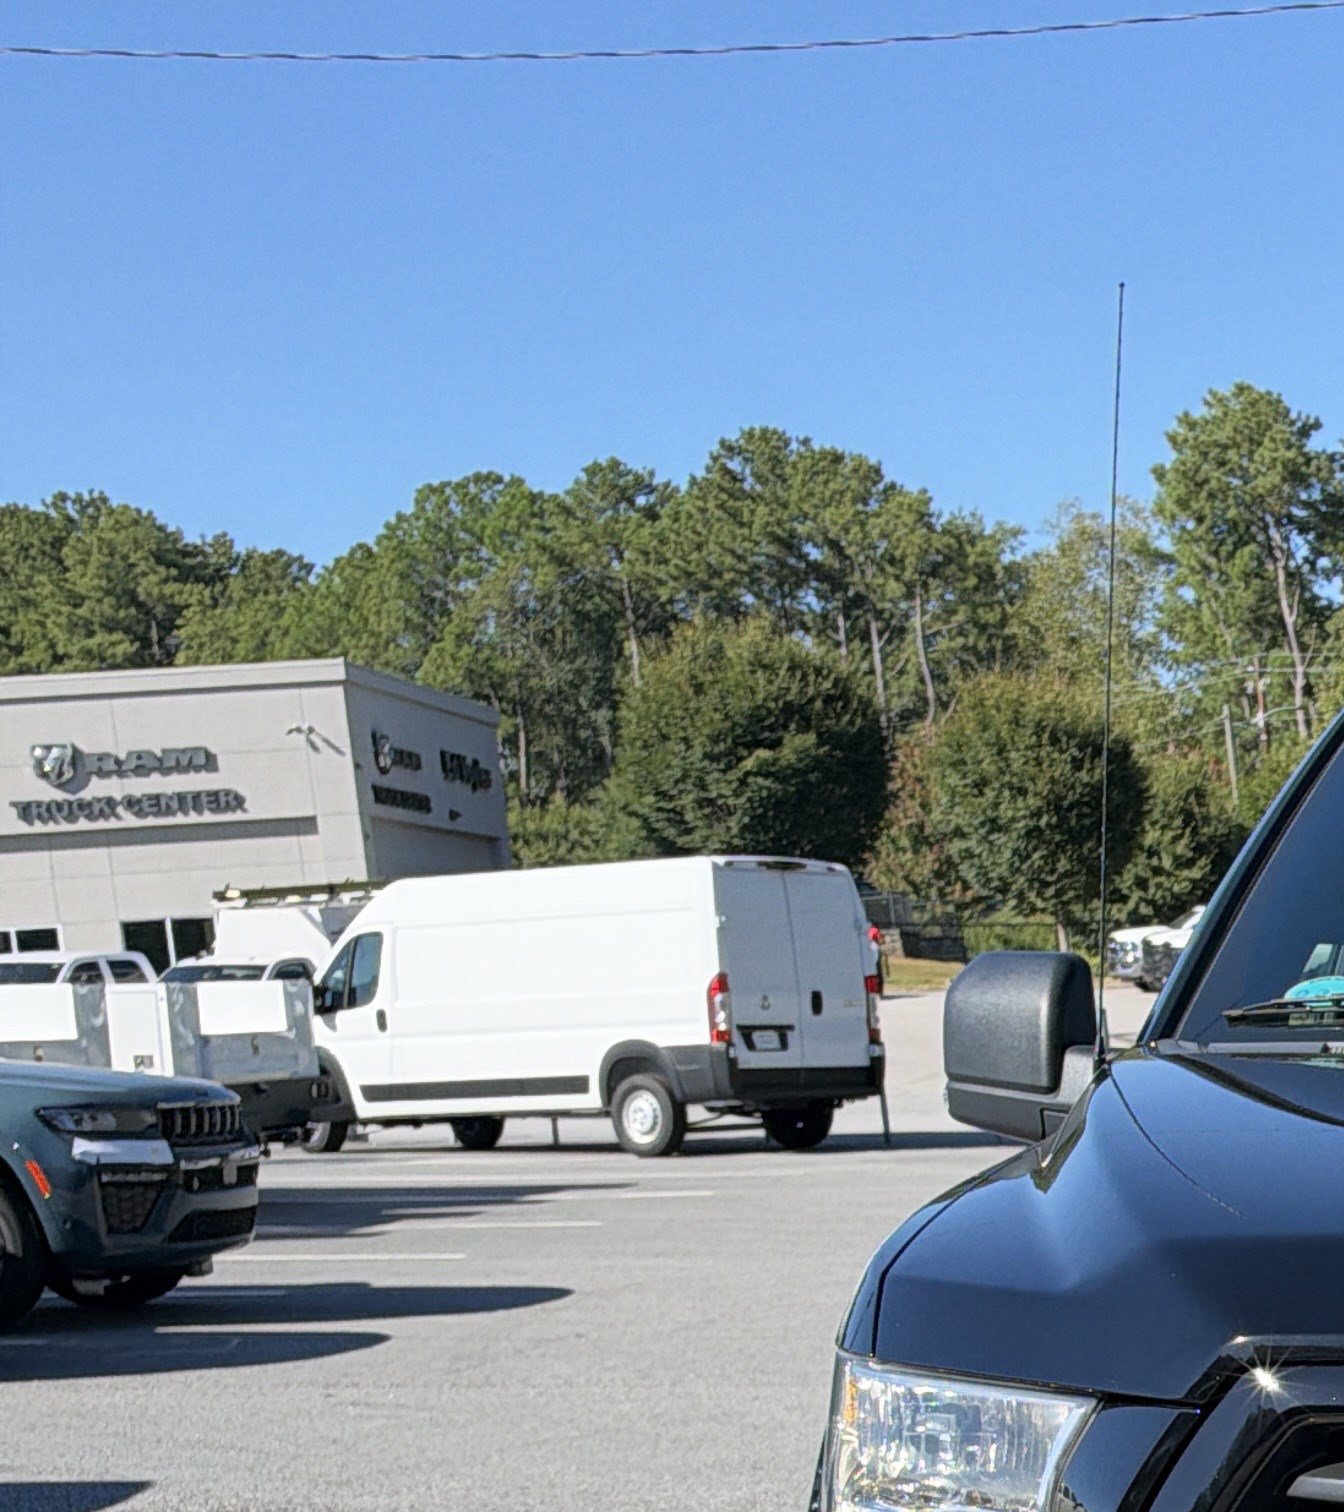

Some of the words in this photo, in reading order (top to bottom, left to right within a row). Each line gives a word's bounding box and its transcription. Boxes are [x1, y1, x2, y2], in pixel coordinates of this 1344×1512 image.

[85, 746, 209, 773] RAM
[9, 797, 120, 825] TRUCK
[121, 789, 244, 818] CENTER
